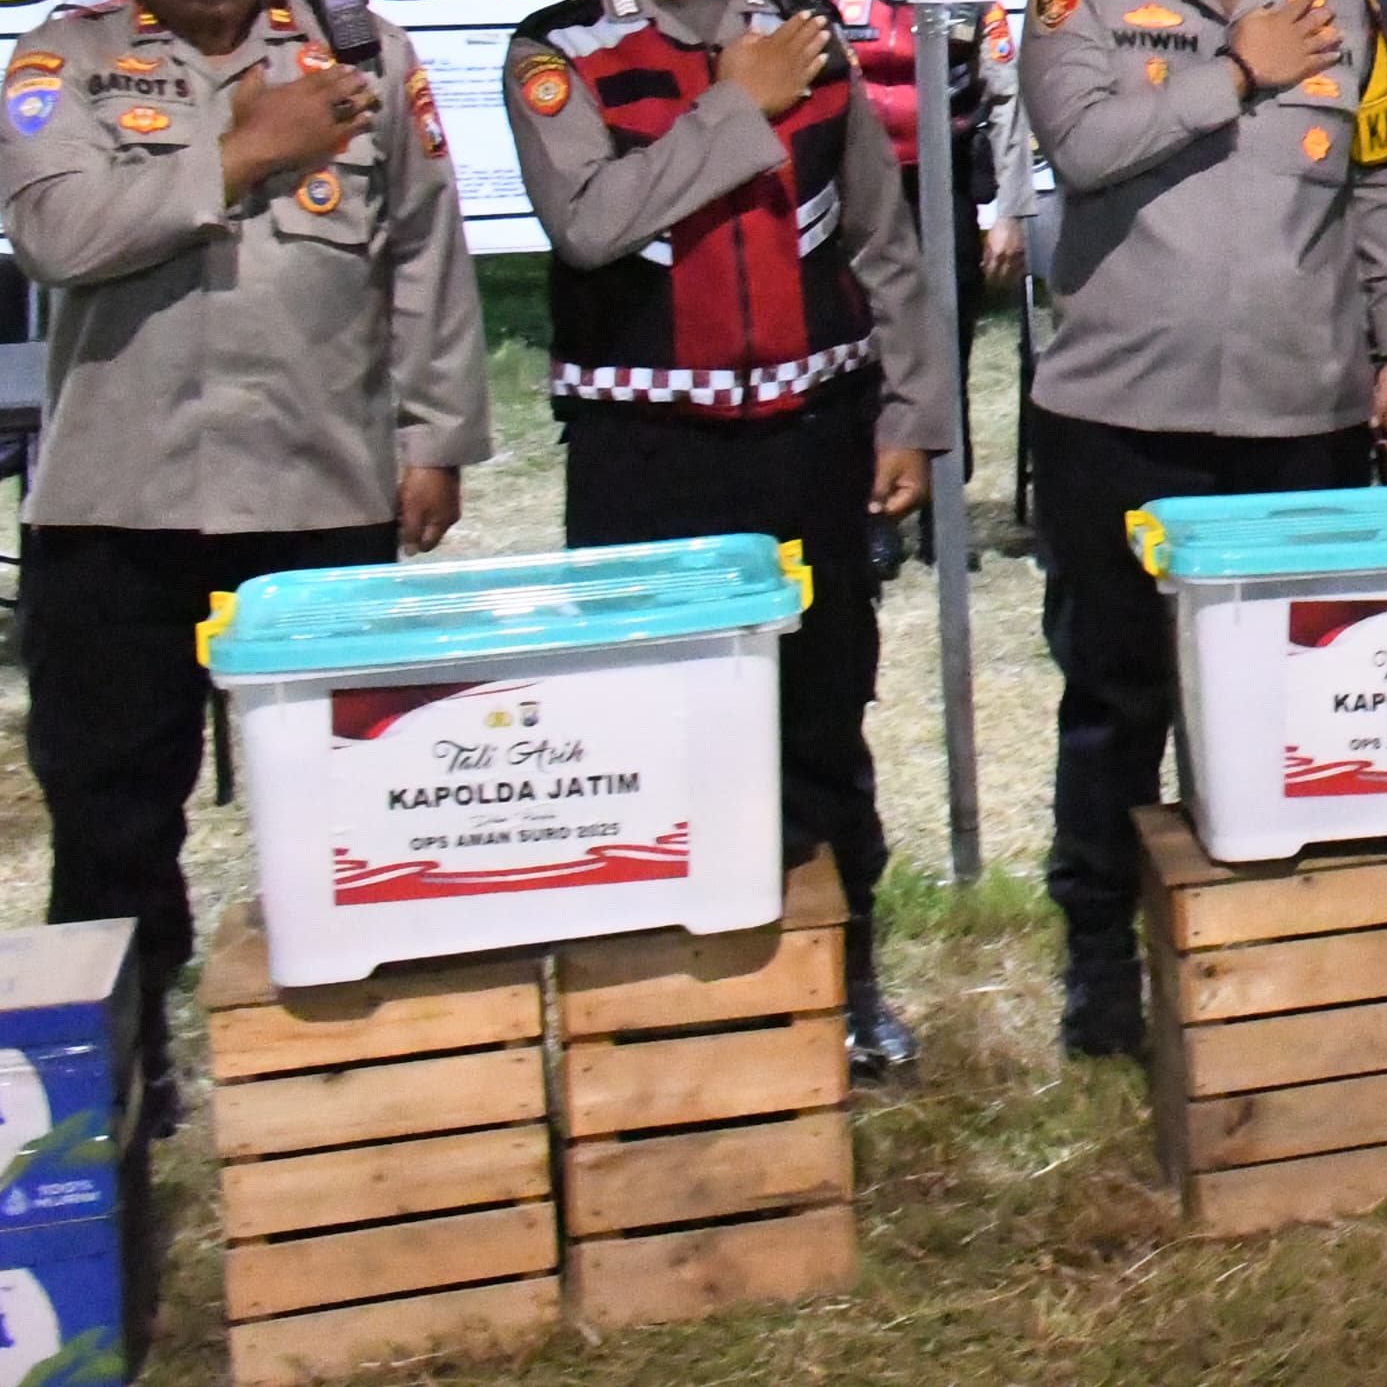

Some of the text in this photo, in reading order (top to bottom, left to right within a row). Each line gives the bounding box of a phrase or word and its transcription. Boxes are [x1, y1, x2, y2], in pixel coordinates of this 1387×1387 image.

[432, 739, 494, 775] Tali
[388, 772, 641, 811] KAPOLDA JATIM
[409, 821, 622, 852] OPS AMAN SURO 2025
